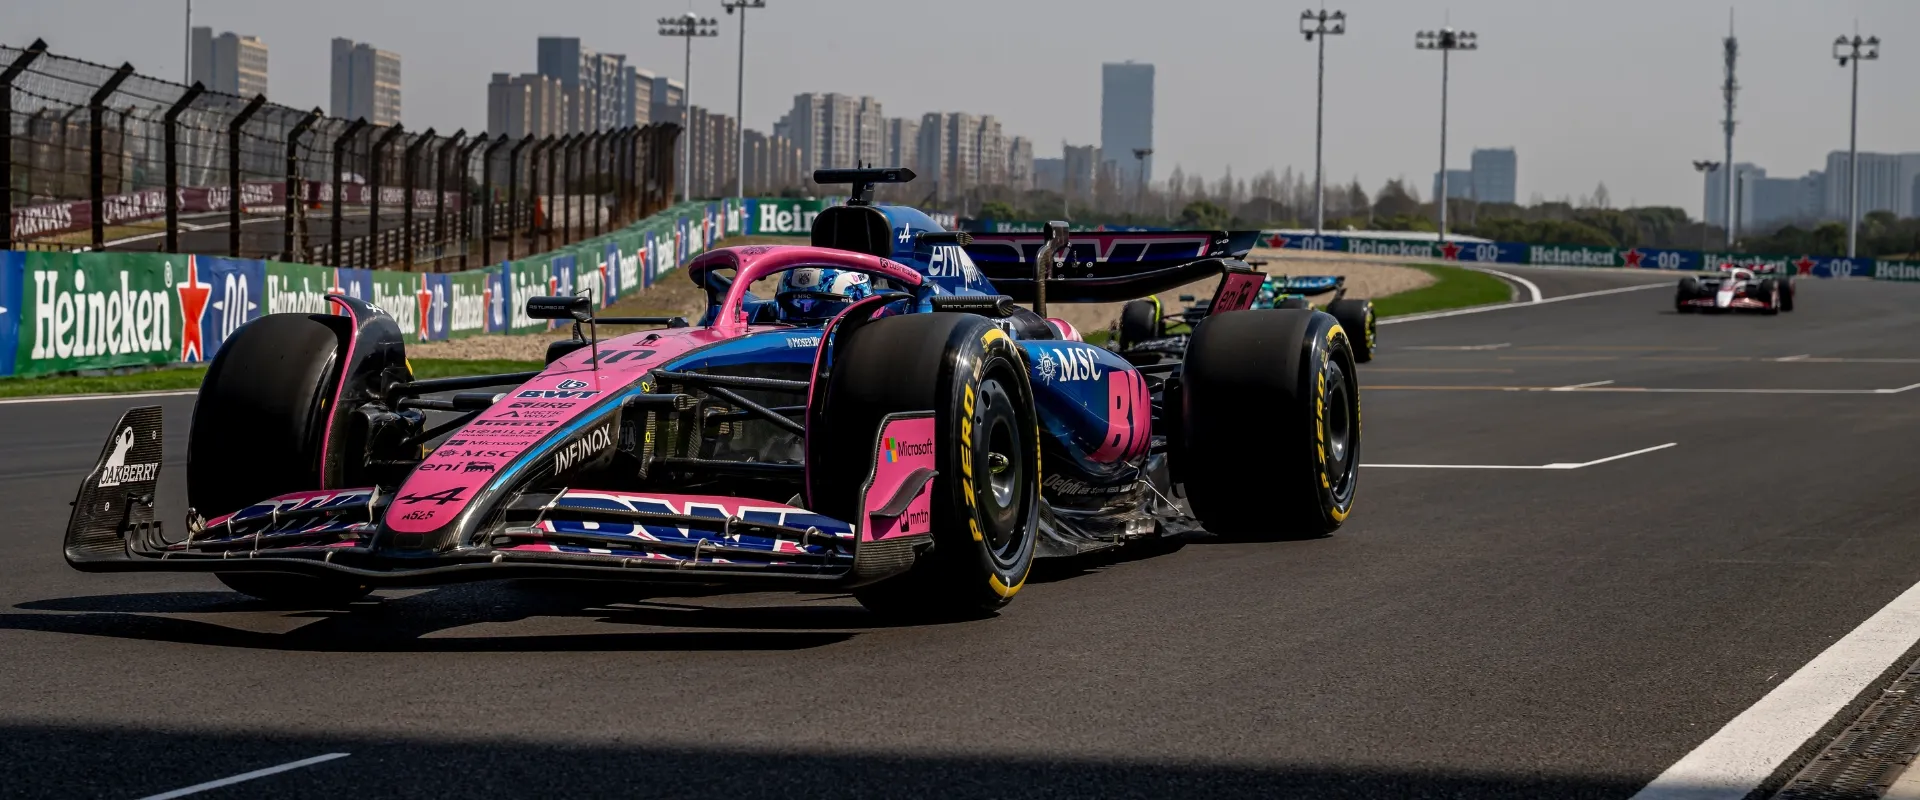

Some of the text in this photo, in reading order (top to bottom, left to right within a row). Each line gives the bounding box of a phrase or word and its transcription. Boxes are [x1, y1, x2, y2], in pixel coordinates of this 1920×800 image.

[103, 194, 140, 224] QATAR
[14, 203, 72, 236] AIRWAYS
[1348, 239, 1432, 257] Heineken
[1530, 245, 1615, 266] Heineken
[31, 269, 172, 360] Heineken
[581, 349, 657, 364] 10
[1052, 347, 1102, 382] MSC
[515, 389, 602, 400] BWT
[474, 419, 560, 427] PIRELLI
[461, 450, 519, 458] MSC
[554, 423, 612, 476] INFINOX
[897, 438, 933, 457] Microsoft
[961, 382, 976, 508] ZERO
[101, 462, 158, 486] OAKBERRY
[419, 462, 464, 472] eni
[909, 510, 929, 525] mntn
